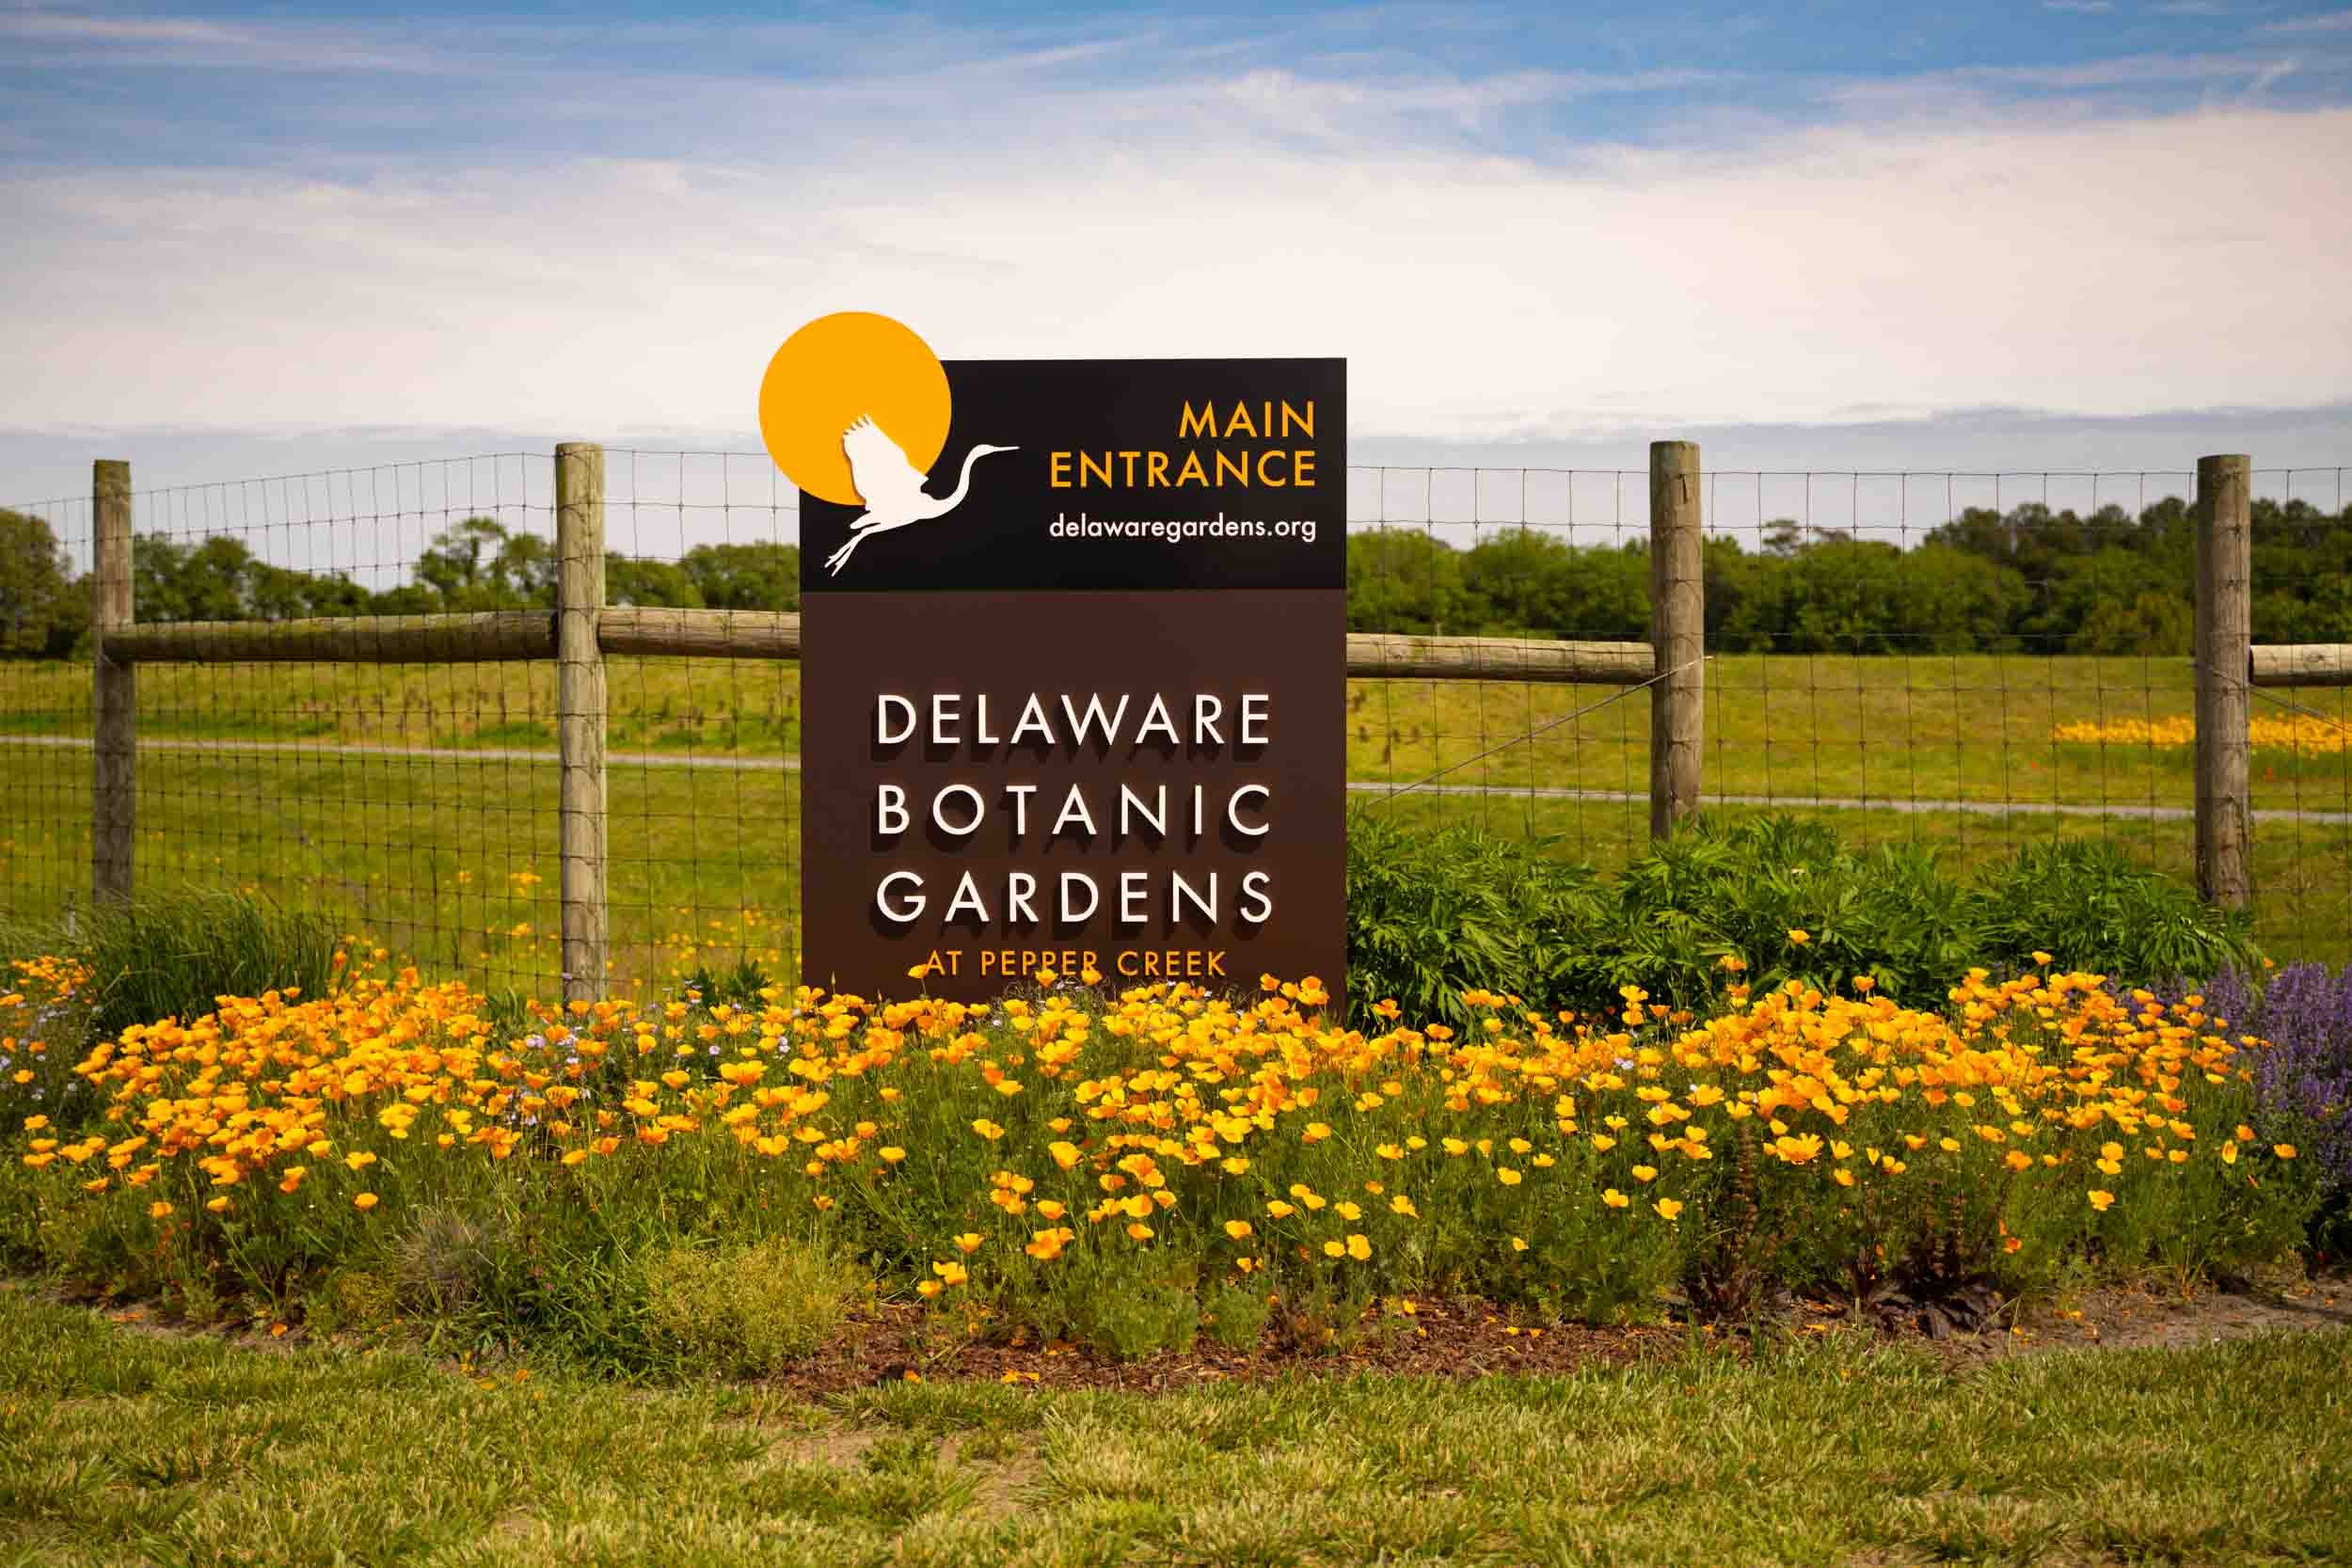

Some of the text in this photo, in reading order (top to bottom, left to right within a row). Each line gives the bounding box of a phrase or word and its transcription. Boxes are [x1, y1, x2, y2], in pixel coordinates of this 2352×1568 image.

[1178, 400, 1316, 438] MAIN
[1050, 450, 1317, 488] ENTRANCE
[1049, 513, 1317, 543] delawaregardens.org
[877, 693, 1271, 745] DELAWARE
[878, 784, 1272, 837] BOTANIC
[876, 871, 1273, 924] GARDENS
[926, 950, 1228, 977] AT PEPPER CREEK
